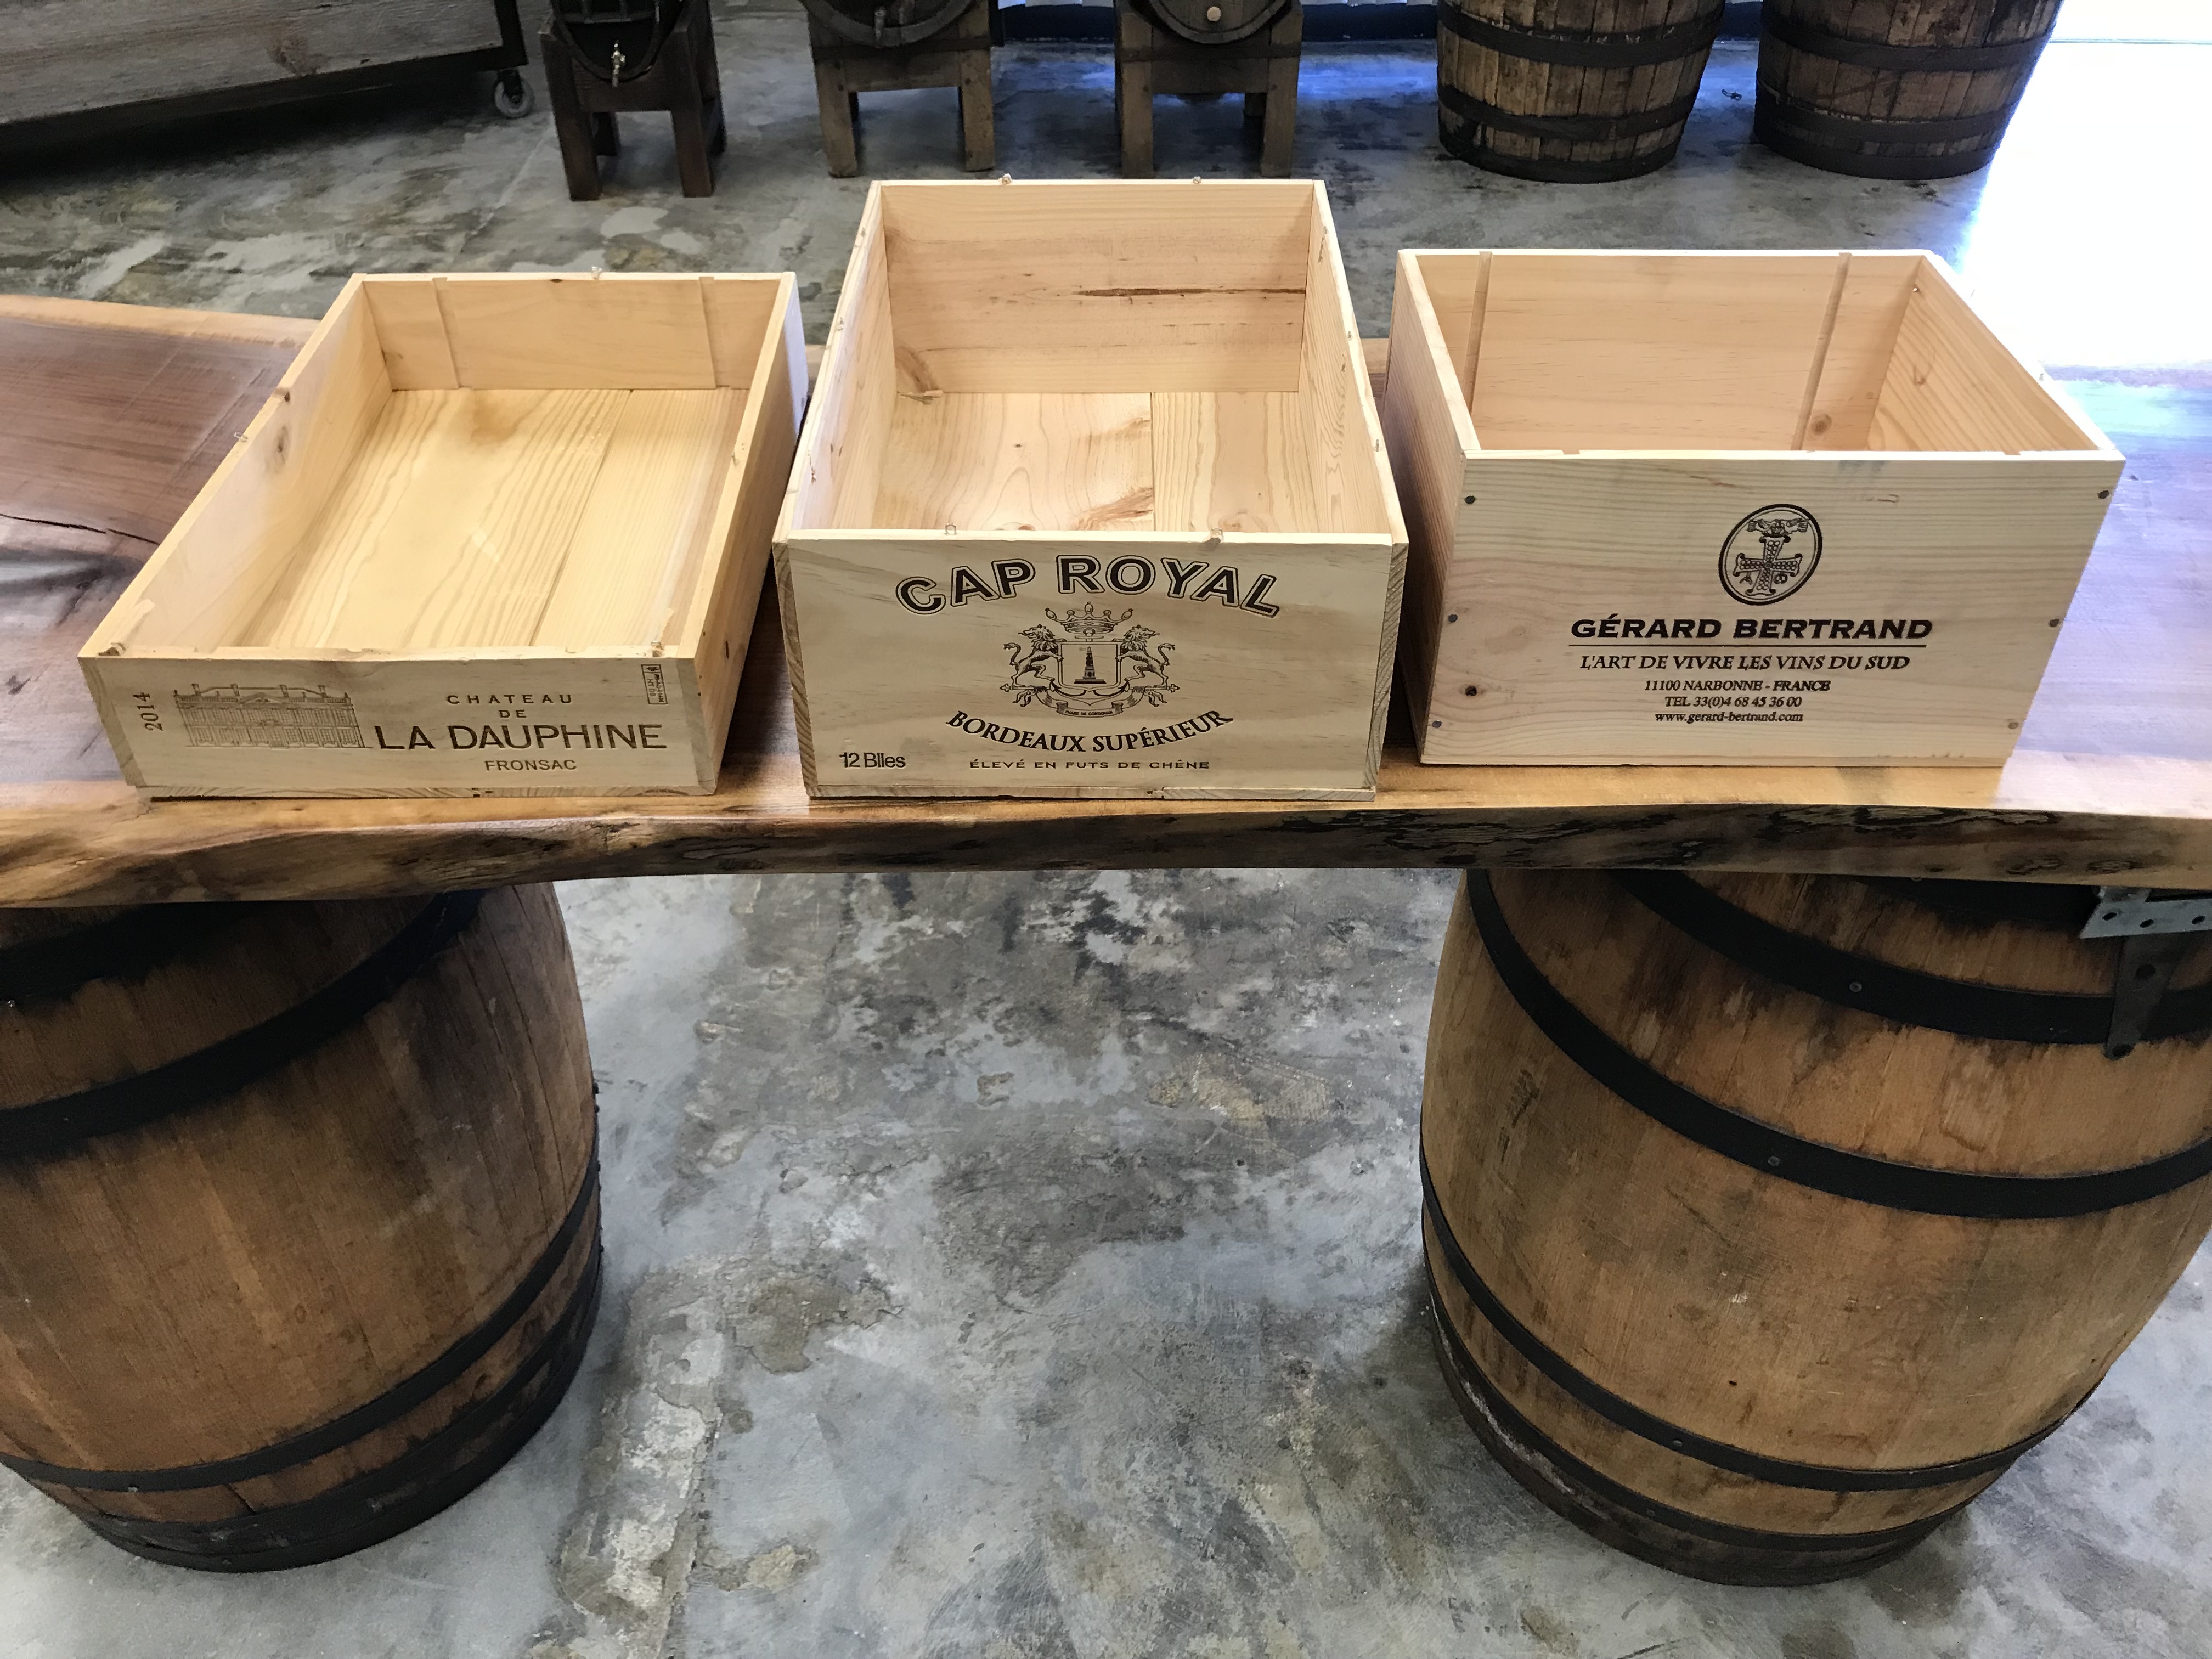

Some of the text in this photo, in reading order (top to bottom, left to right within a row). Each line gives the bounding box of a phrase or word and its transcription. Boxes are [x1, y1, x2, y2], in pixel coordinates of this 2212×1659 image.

[895, 555, 1279, 618] CAP ROYAL
[1571, 613, 1933, 639] GÉRARD BERTRAND
[1579, 655, 1910, 670] L'ART DE VIVRE LES VINS DU SUD
[1644, 680, 1681, 691] 11100
[1684, 680, 1763, 691] NARBONNE
[1773, 680, 1831, 692] FRANCE
[446, 694, 572, 704] CHATEAU
[1664, 696, 1802, 708] TEL 33(0)4 68 45 36 00
[132, 692, 163, 731] 2014
[498, 709, 527, 718] DE
[1655, 712, 1803, 724] www.gerard-bertrand.com
[374, 724, 667, 750] LA DAUPHINE
[945, 710, 1234, 752] BORDEAUX SUPÉRIEUR
[484, 759, 577, 771] FRONSAC
[839, 752, 861, 768] 12
[969, 759, 1025, 769] ÉLEVÉ
[1149, 759, 1210, 769] CHÊNE
